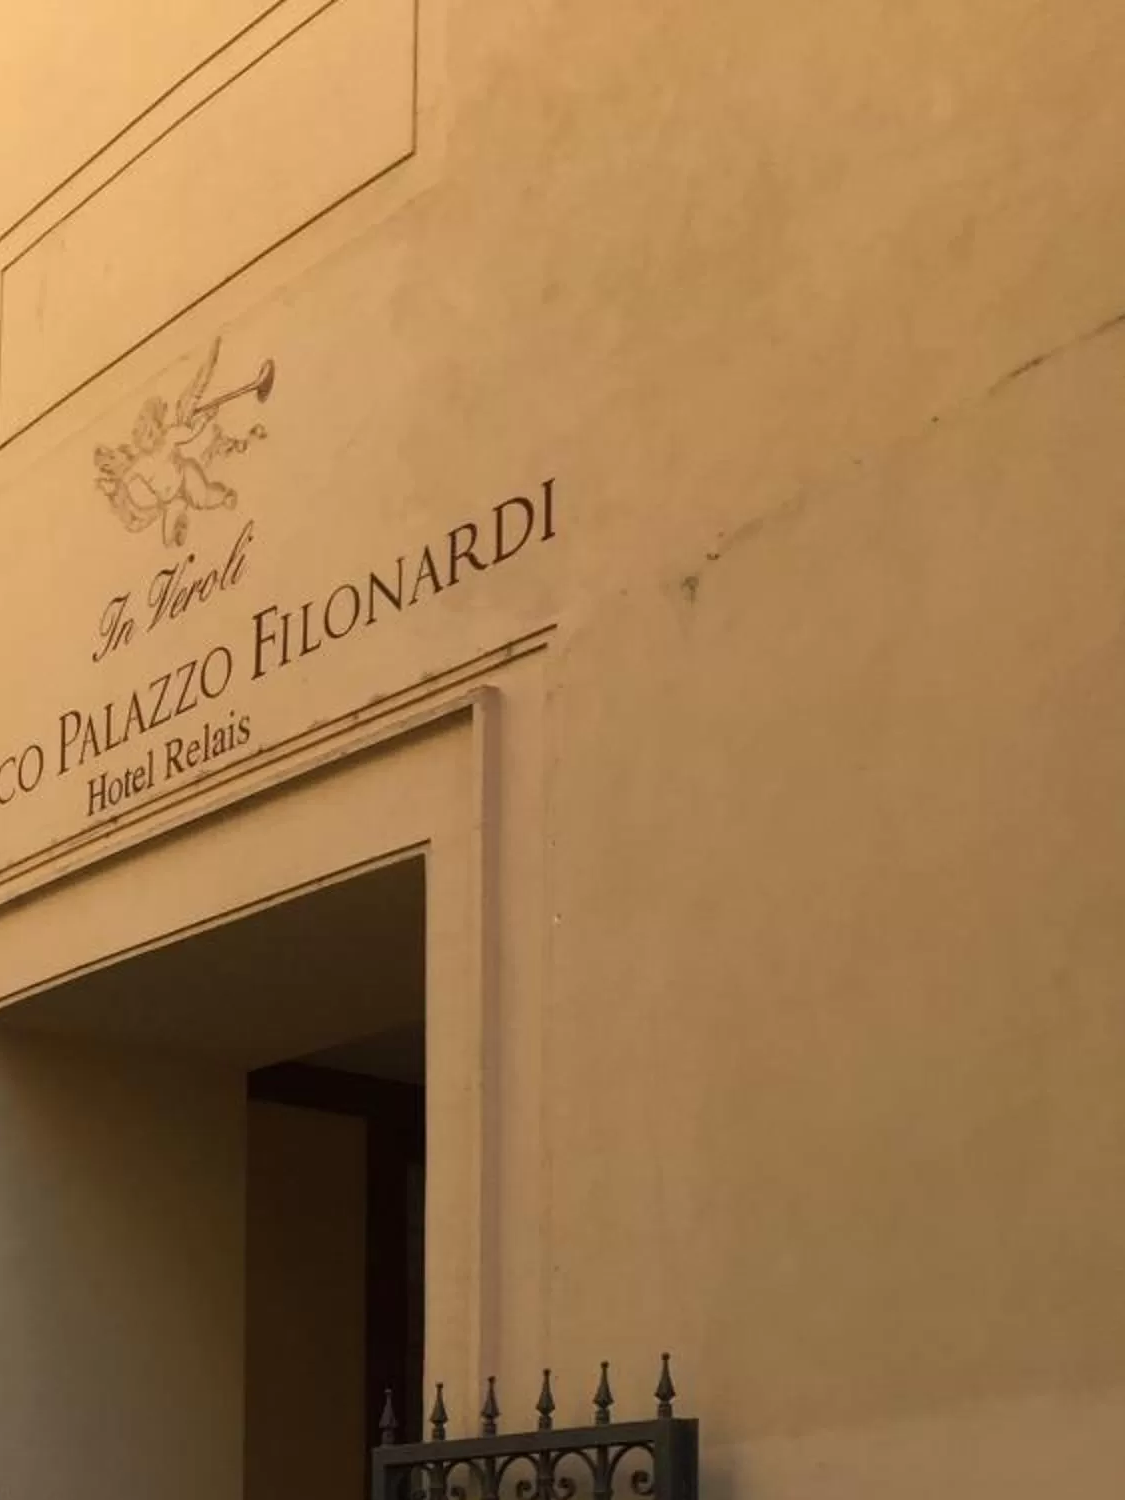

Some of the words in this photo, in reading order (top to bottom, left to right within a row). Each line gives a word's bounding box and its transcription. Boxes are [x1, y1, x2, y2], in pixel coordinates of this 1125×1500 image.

[58, 646, 233, 776] PALAZZO
[250, 478, 556, 681] FILONARDI
[92, 593, 135, 663] In
[148, 519, 255, 633] Veroli
[86, 765, 155, 816] Hotel
[164, 711, 251, 780] Relais
